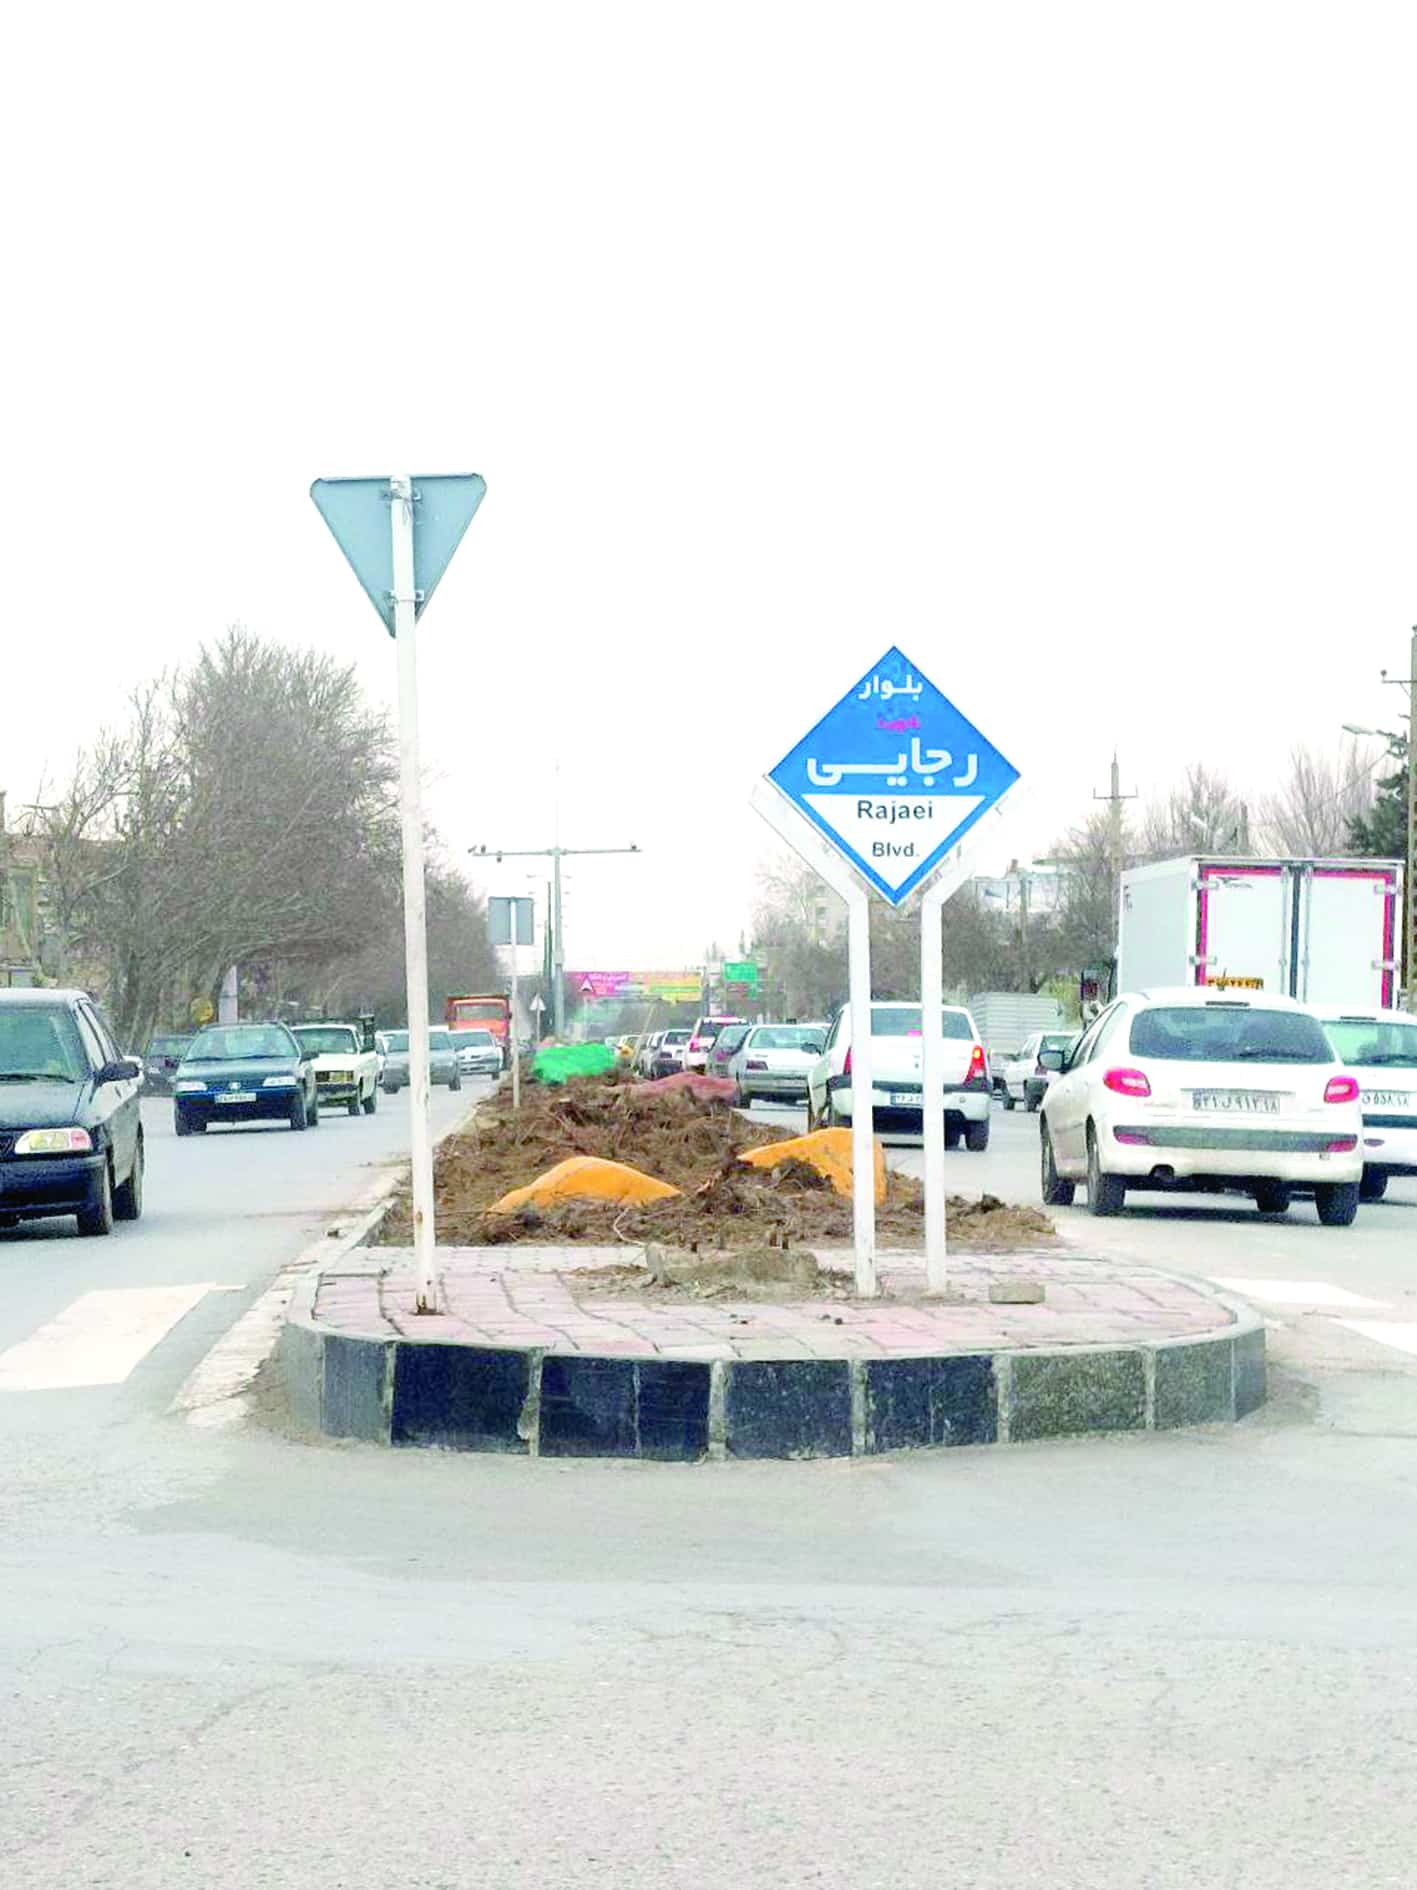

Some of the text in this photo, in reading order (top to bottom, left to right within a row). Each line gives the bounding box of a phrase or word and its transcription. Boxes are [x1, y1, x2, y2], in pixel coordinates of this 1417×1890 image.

[858, 675, 923, 700] بلوار
[806, 737, 978, 788] رجایی
[857, 800, 934, 824] Rajaei
[872, 842, 919, 858] Blvd.
